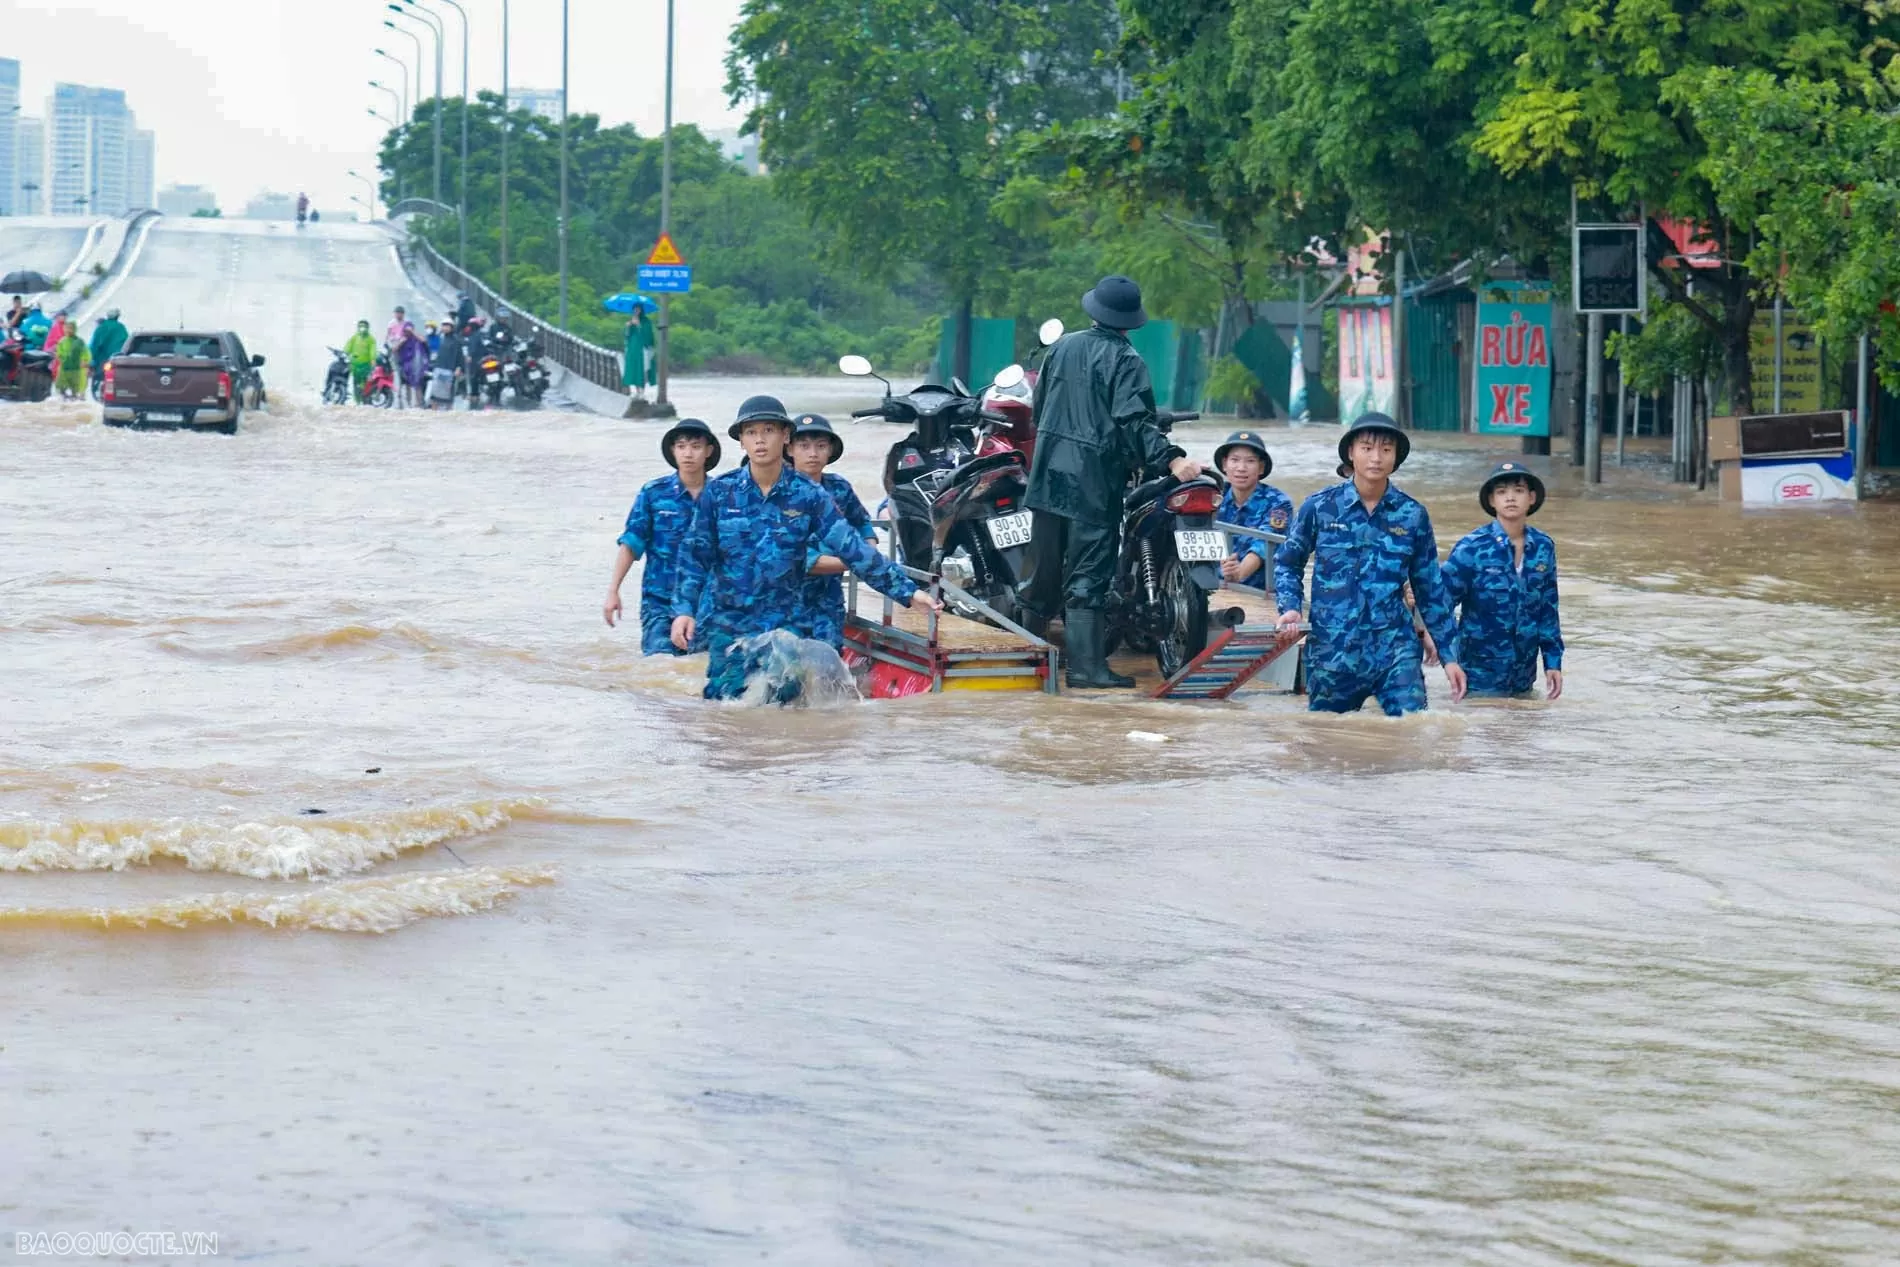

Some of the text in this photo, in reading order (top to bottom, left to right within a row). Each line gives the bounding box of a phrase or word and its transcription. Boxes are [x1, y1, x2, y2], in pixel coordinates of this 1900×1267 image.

[1481, 310, 1548, 367] RỬA
[1489, 383, 1532, 426] XE
[995, 527, 1031, 547] 090.9
[1181, 545, 1224, 559] 952.67
